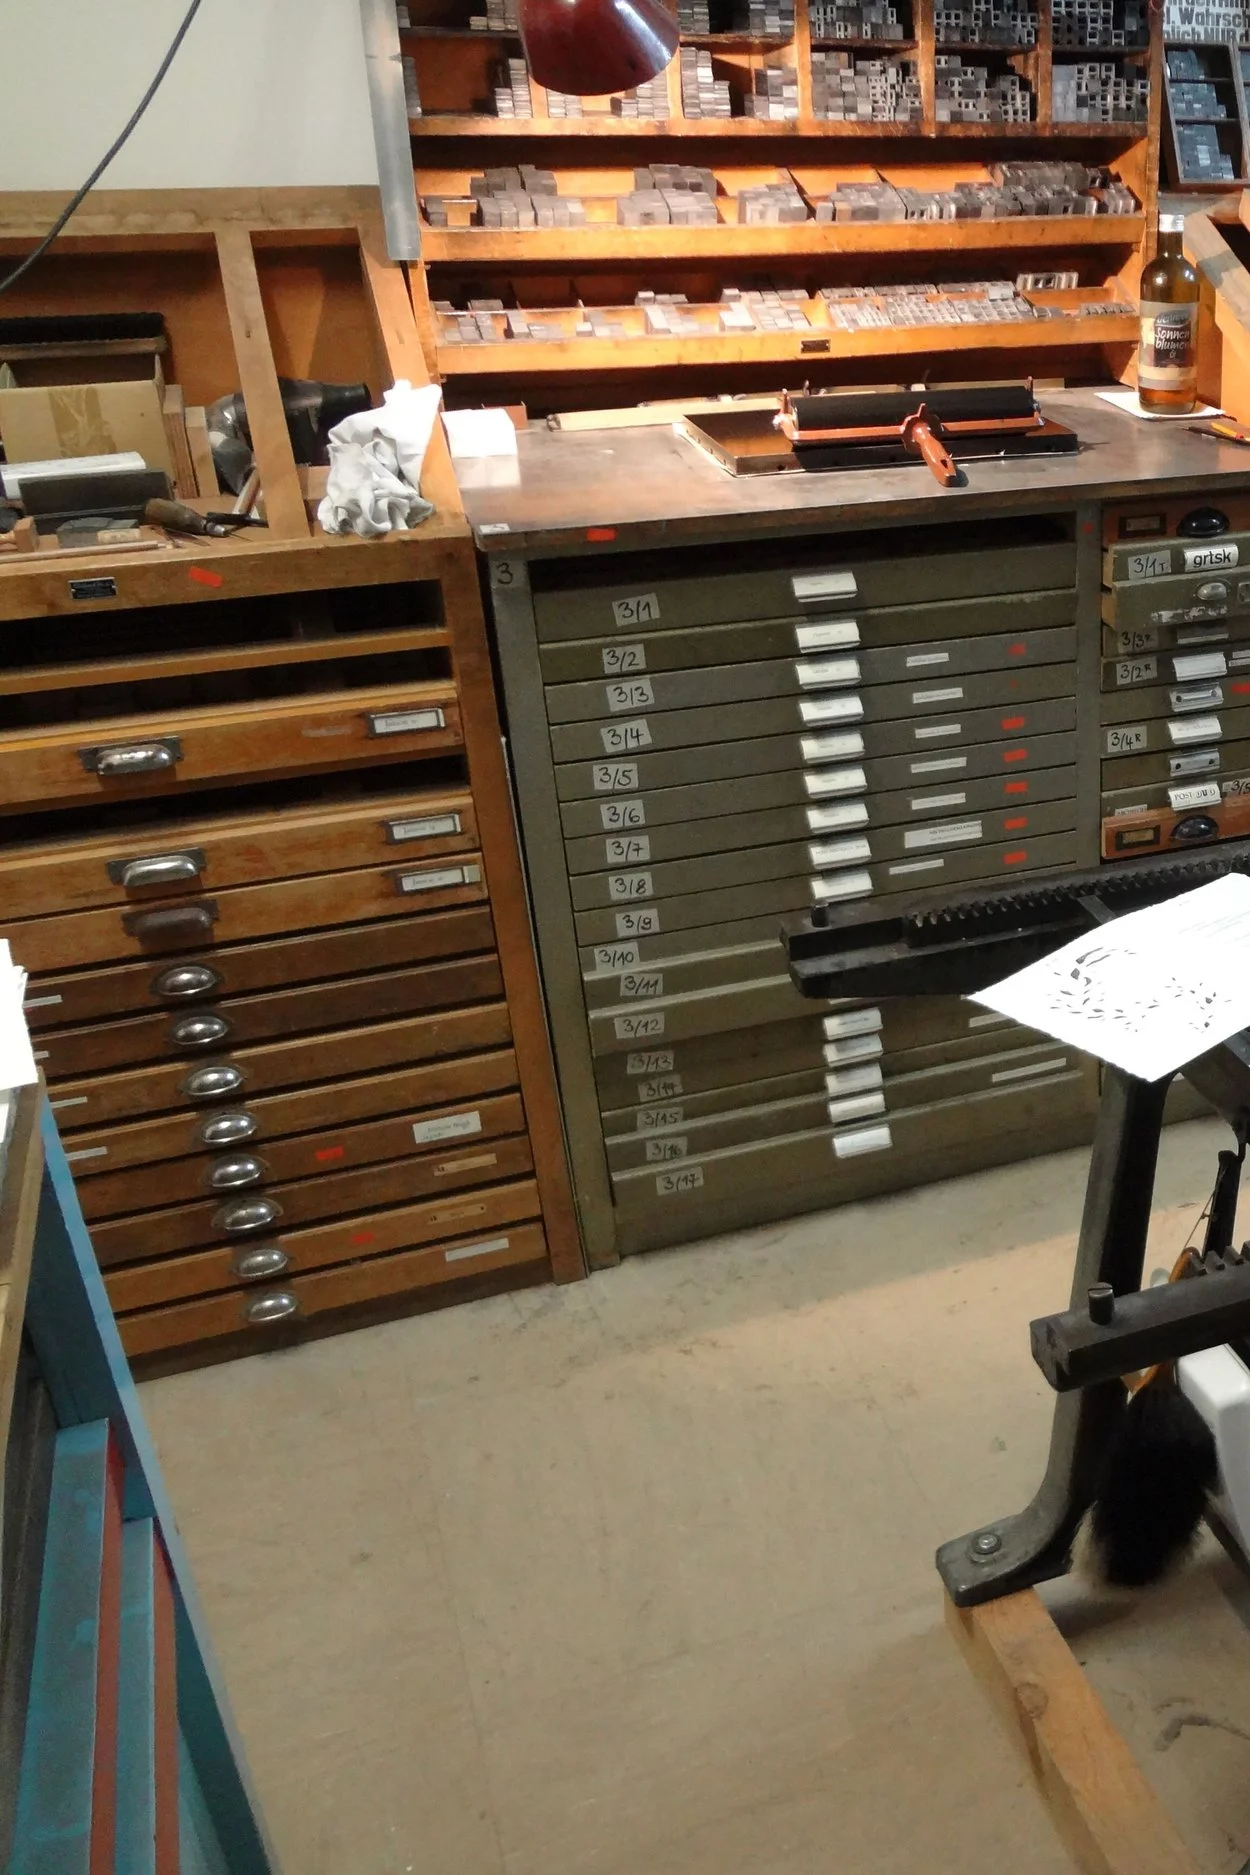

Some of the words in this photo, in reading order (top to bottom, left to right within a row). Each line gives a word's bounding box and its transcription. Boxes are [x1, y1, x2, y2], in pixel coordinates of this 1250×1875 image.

[1193, 549, 1231, 568] grtsk
[496, 562, 514, 585] 3
[618, 600, 652, 621] 3/1
[606, 649, 640, 673] 3/2
[613, 686, 650, 706] 3/3
[607, 728, 644, 750] 3/4
[598, 766, 633, 792] 3/5
[606, 806, 641, 827] 3/6
[612, 840, 644, 861] 3/7
[614, 877, 647, 895] 3/8
[622, 913, 653, 933] 3/9
[599, 949, 635, 968] 3/10
[624, 975, 659, 995] 3/11
[623, 1018, 661, 1038] 3/12
[644, 1112, 678, 1128] 3/15
[663, 1172, 700, 1192] 3/17
